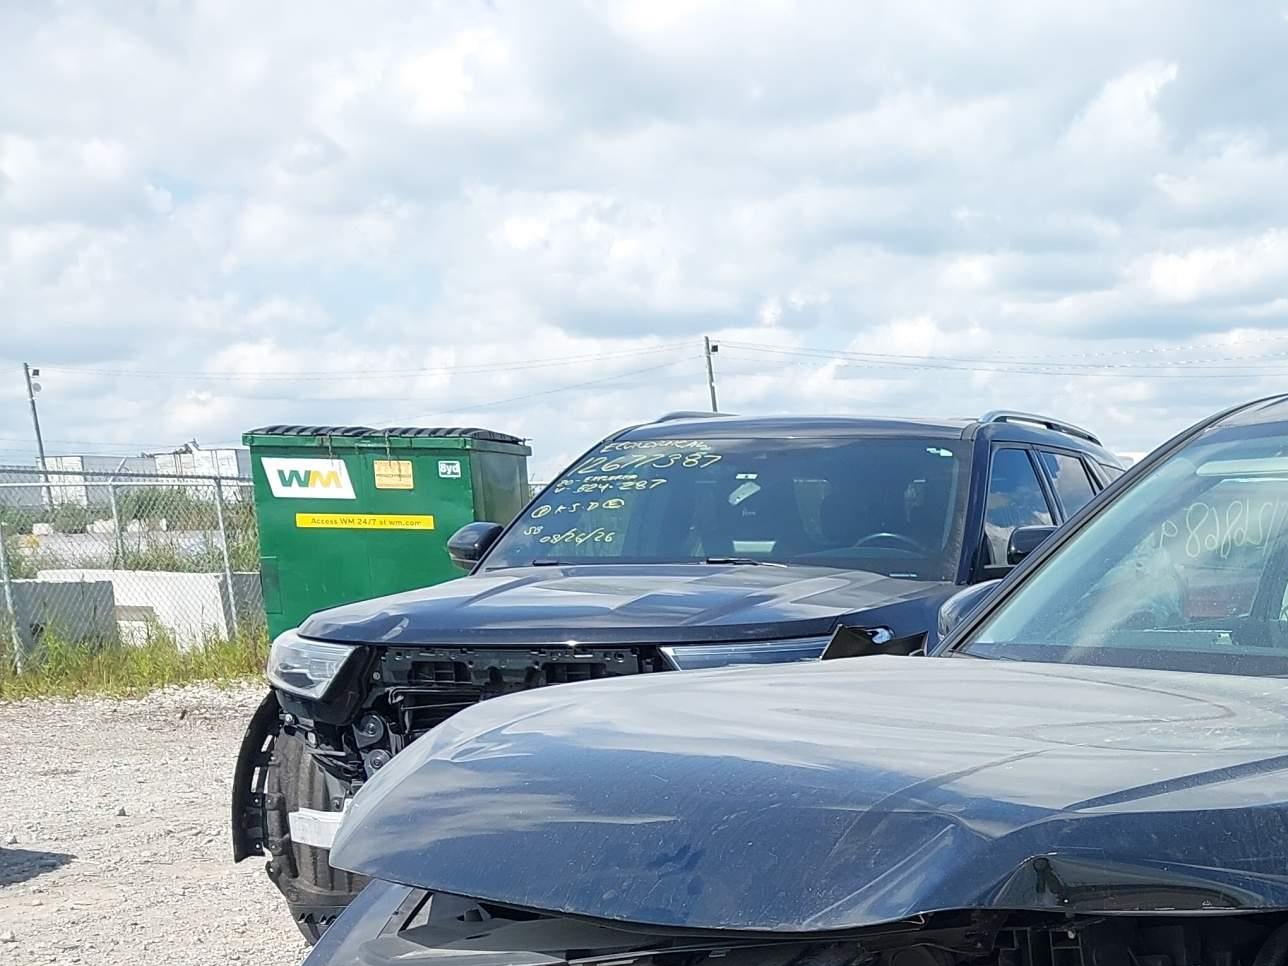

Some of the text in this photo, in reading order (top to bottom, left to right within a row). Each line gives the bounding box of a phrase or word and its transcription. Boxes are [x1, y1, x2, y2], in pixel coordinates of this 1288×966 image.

[567, 452, 722, 477] 12677387
[277, 469, 342, 489] WM
[311, 518, 338, 526] Access
[340, 518, 355, 526] WM
[357, 518, 377, 526] 24/7
[539, 527, 616, 546] 08/26/26
